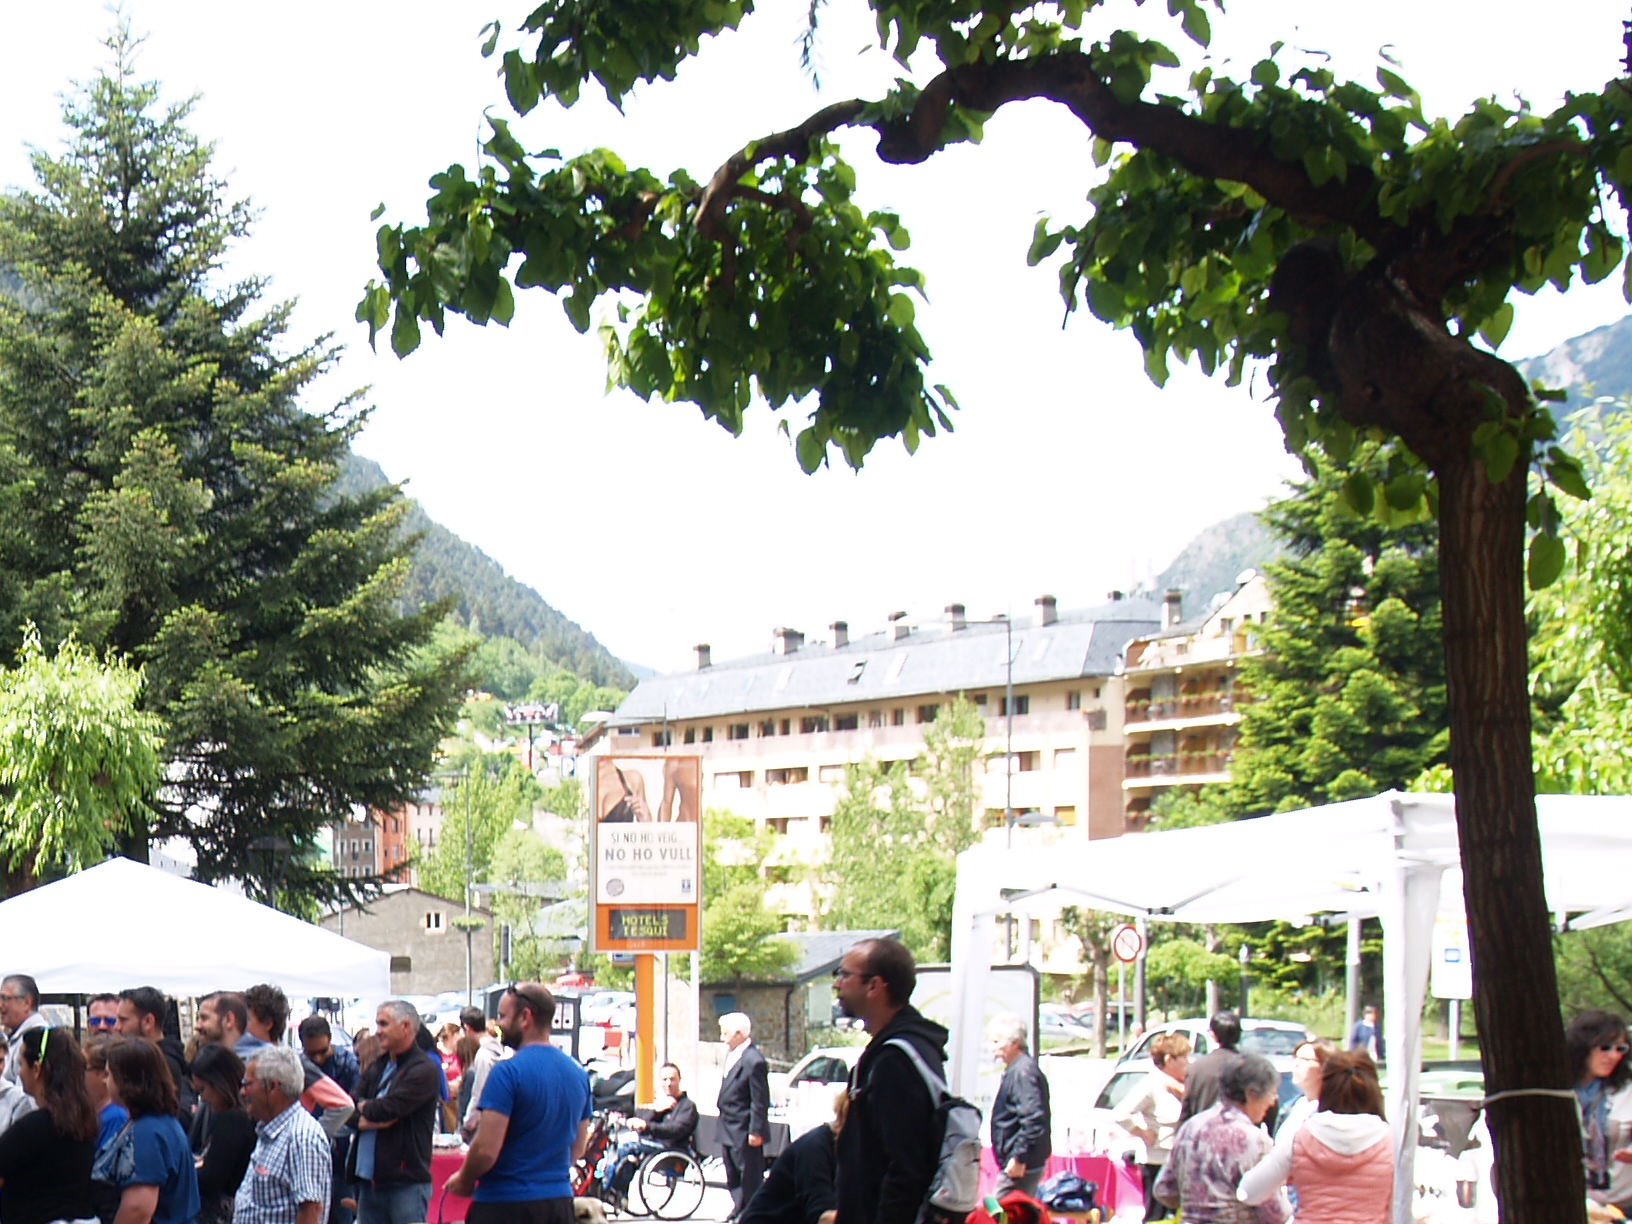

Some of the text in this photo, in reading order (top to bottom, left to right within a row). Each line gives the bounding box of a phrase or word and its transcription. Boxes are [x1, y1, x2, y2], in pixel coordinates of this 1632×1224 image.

[611, 832, 620, 844] SI
[623, 832, 637, 843] NO
[640, 832, 653, 843] HO
[605, 848, 692, 861] NO HO VULL
